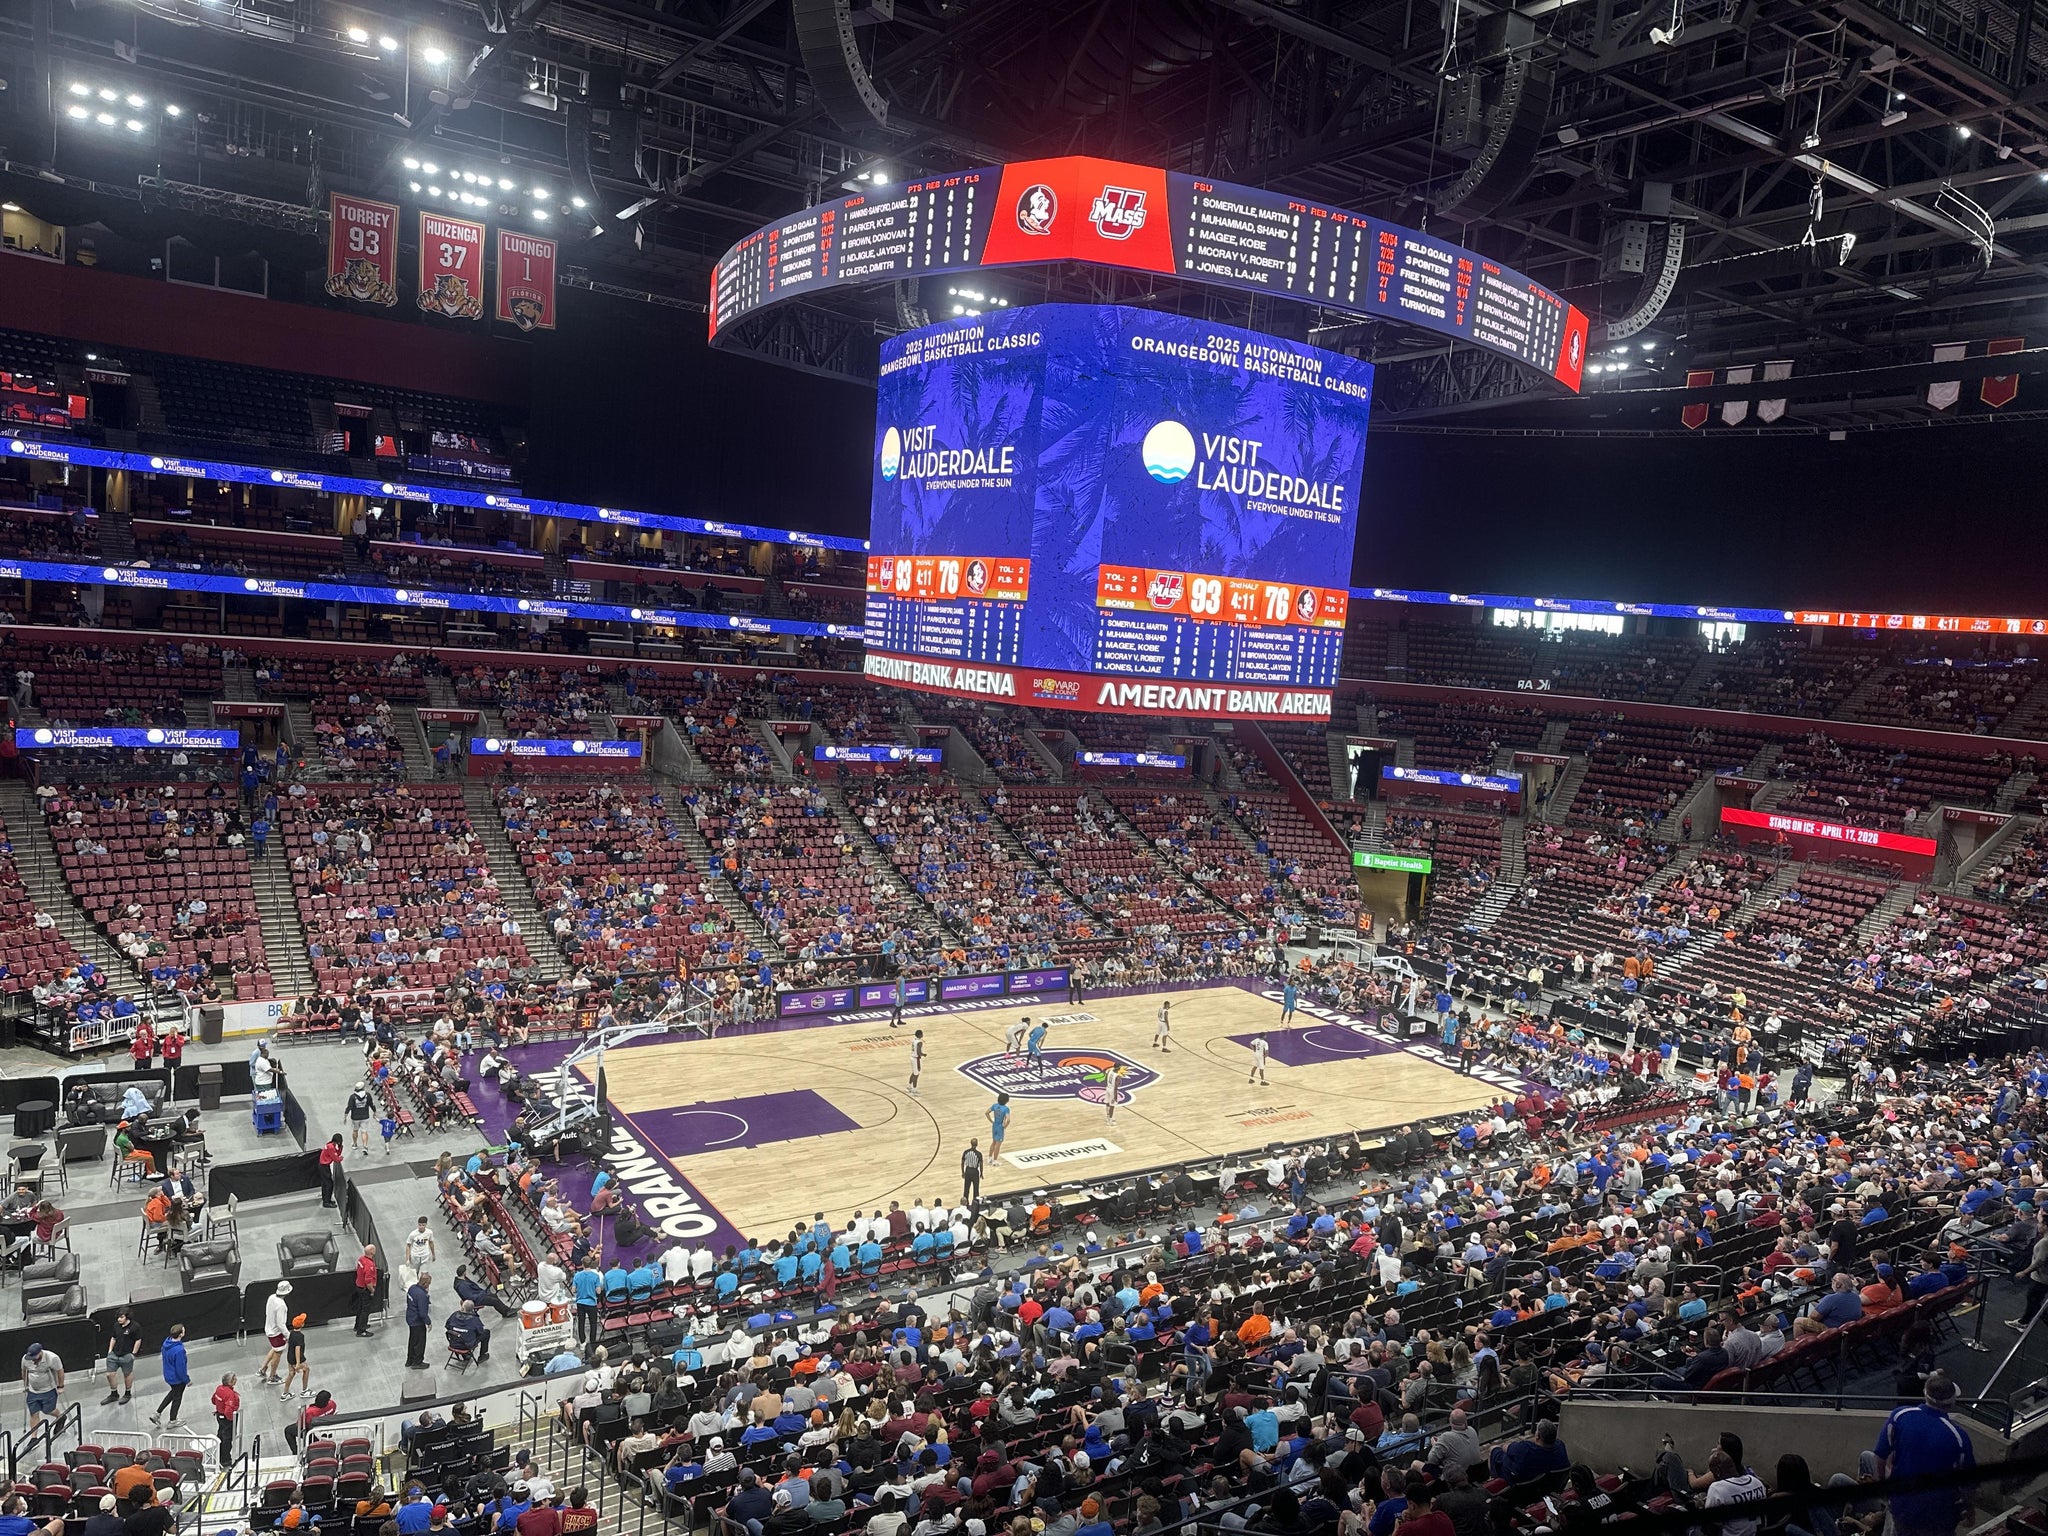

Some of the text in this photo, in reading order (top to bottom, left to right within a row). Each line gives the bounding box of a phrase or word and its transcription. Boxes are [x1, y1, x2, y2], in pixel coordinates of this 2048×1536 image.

[908, 175, 980, 193] PTS REB AST FLS
[1194, 182, 1213, 193] FSU
[340, 204, 390, 228] TORREY
[1203, 198, 1290, 224] SOMERVILLE, MARTIN
[1289, 202, 1367, 229] PTS REB AST FLS
[426, 220, 478, 244] HUIZENGA
[1201, 214, 1288, 239] MUHAMMAD, SHAHID
[349, 228, 380, 255] 93
[504, 236, 550, 259] LUONGO
[1200, 230, 1267, 251] MAGEE, KOBE
[439, 243, 467, 270] 37
[1198, 246, 1285, 270] MCCRAY ROBERT
[1405, 240, 1453, 264] FIELD GOALS
[522, 257, 532, 281] 1
[783, 258, 812, 273] REBOUNDS
[1197, 262, 1268, 283] JONES, LAJAE
[1412, 258, 1450, 277] POINTERS
[781, 271, 812, 286] TURNOVERS
[1400, 268, 1451, 292] FREE THROWS
[1404, 284, 1444, 304] REBOUNDS
[1400, 297, 1445, 318] TURNOVERS
[905, 326, 984, 354] 2025 AUTONATION
[881, 332, 1040, 376] ORANGEBOWL BASKETBALL CLASSIC
[1207, 335, 1322, 373] 2025 AUTONATION
[1131, 336, 1367, 399] ORANGEBOWL BASKETBALL CLASSIC
[112, 376, 127, 384] 316
[903, 425, 936, 452] VISIT
[25, 449, 69, 459] LAUDERDALE
[1202, 433, 1262, 466] VISIT
[163, 464, 205, 474] LAUDERDALE
[900, 447, 1014, 479] LAUDERDALE
[283, 477, 322, 487] LAUDERDALE
[926, 478, 1012, 490] EVERYONE UNDER THE SUN
[1197, 462, 1344, 511] LAUDERDALE
[393, 490, 429, 499] LAUDERDALE
[496, 502, 530, 510] LAUDERDALE
[1247, 500, 1340, 523] EVERYONE UNDER THE SUN
[119, 575, 168, 586] LAUDERDALE
[895, 560, 912, 592] 93
[916, 570, 932, 586] 4:11
[939, 560, 959, 594] 76
[258, 586, 304, 595] LAUDERDALE
[997, 591, 1021, 599] BONUS
[1190, 578, 1222, 614] 93
[408, 596, 449, 606] LAUDERDALE
[530, 606, 567, 614] LAUDERDALE
[1105, 599, 1135, 608] BONUS
[1231, 592, 1255, 610] 4:11
[1265, 586, 1290, 621] 76
[641, 615, 676, 624] LAUDERDALE
[1107, 620, 1168, 631] SOMERVILLE, MARTIN
[1937, 618, 1959, 630] 4:11
[1106, 631, 1144, 641] MUHAMMAD,
[1105, 640, 1160, 652] MAGEE, KOBE
[1104, 652, 1165, 663] MCCRAY ROBERT
[863, 655, 1015, 696] AMERANT BANK ARENA
[1104, 662, 1162, 673] JONES, LAJAE
[1098, 682, 1332, 715] AMERANT BANK ARENA
[216, 706, 280, 715] 115 116
[420, 711, 475, 721] 116 117
[54, 736, 112, 744] LAUDERDALE
[1472, 781, 1508, 789] LAUDERDALE
[1747, 782, 1758, 790] 127
[1947, 810, 1961, 819] 127
[1769, 817, 1878, 844] STARS ON ICE APRIL 2026
[1374, 858, 1423, 869] Baptist Health
[827, 996, 1041, 1022] AMERANT BANK ARENA
[1018, 1143, 1108, 1163] AutoNation
[532, 1325, 563, 1335] GATORADE
[431, 1442, 455, 1450] verizon
[467, 1433, 490, 1442] verizon
